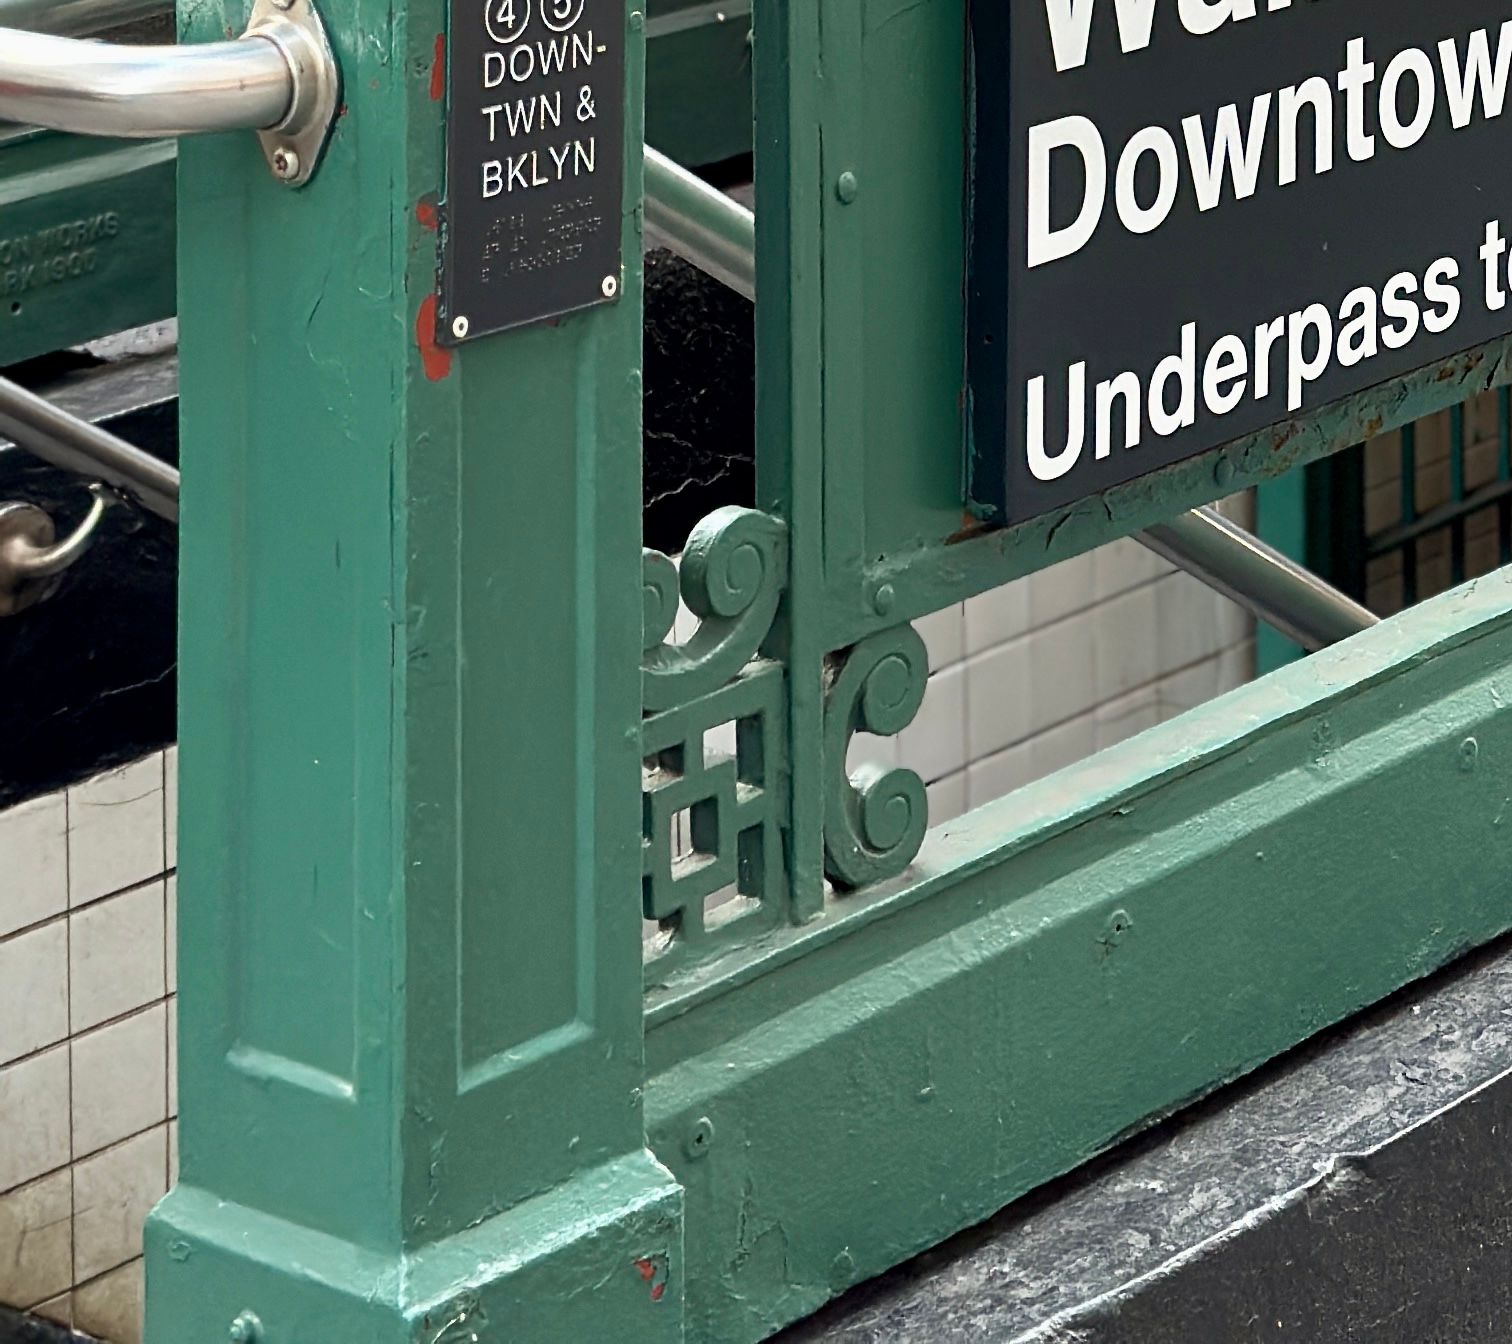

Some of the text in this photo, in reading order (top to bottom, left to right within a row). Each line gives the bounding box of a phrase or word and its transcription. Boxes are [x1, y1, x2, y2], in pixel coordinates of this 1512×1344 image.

[484, 30, 607, 90] DOWN-
[481, 84, 597, 143] TWN &
[481, 136, 596, 199] BKLYN
[1026, 255, 1462, 481] Underpass
